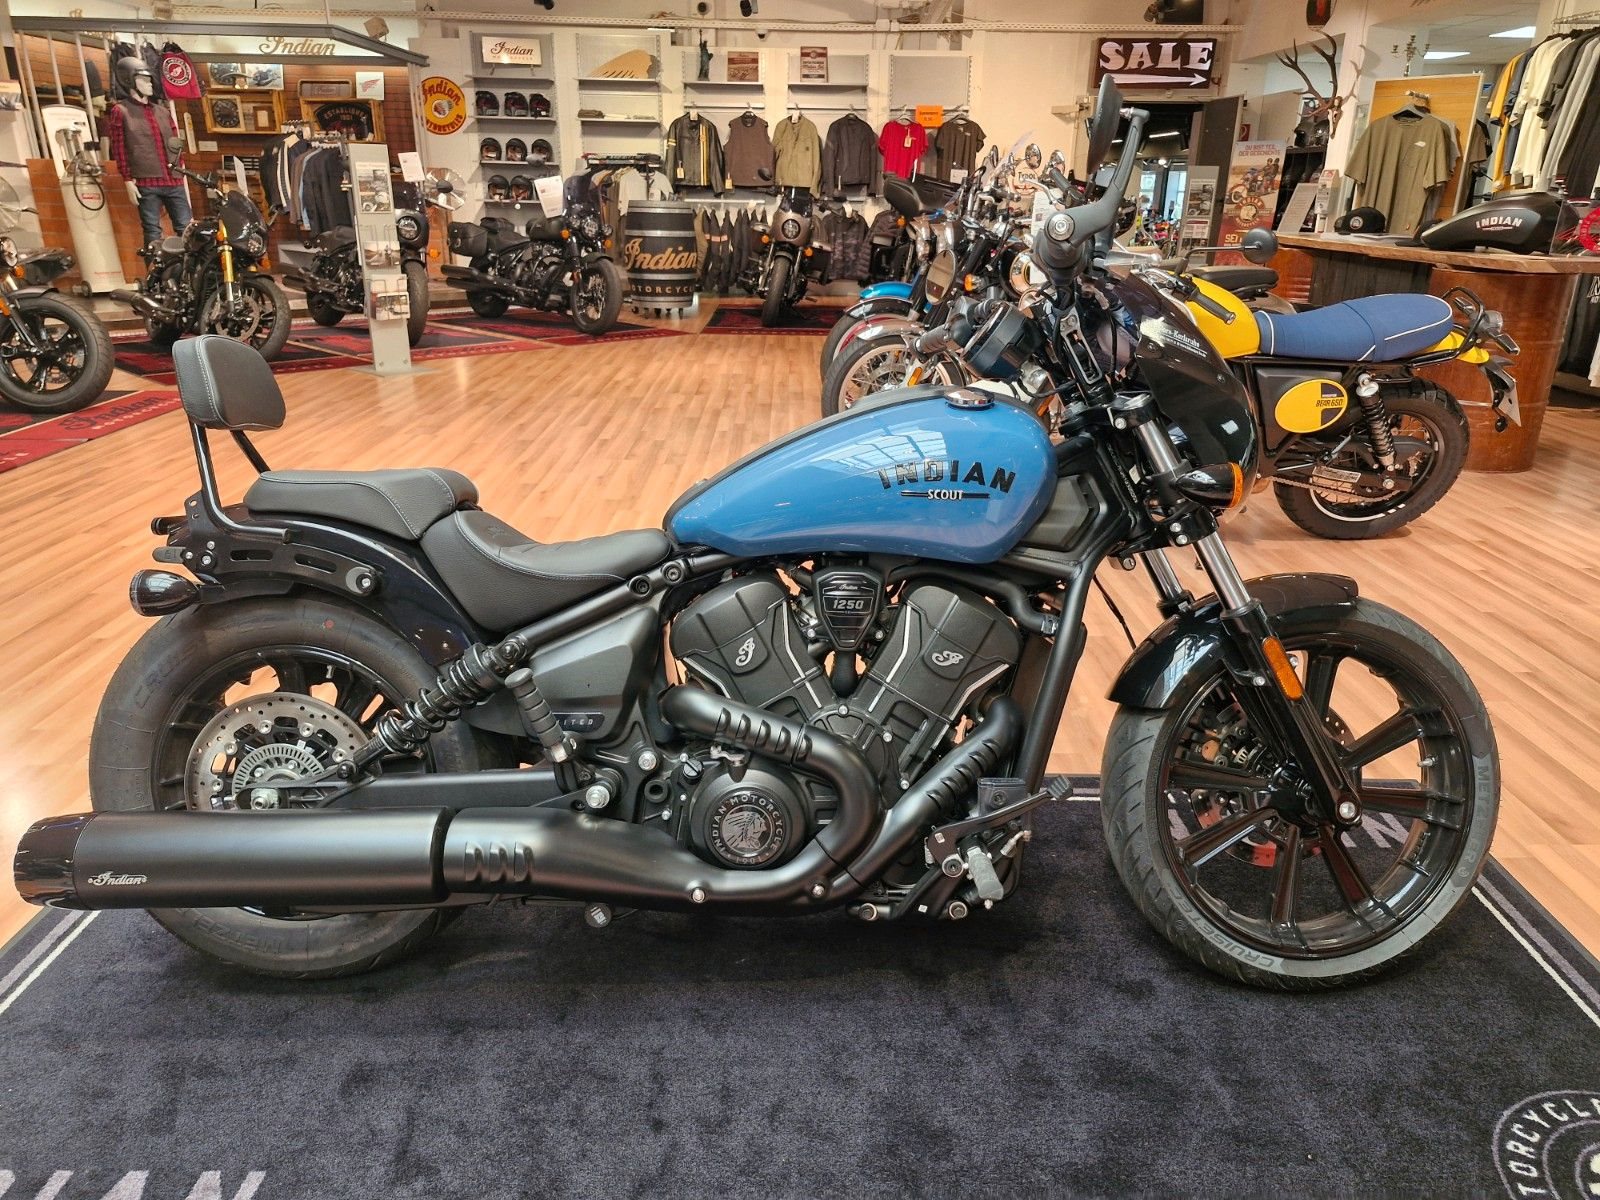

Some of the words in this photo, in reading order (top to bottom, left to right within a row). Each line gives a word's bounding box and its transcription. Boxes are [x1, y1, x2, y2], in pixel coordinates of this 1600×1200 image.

[258, 36, 336, 55] Indian
[490, 41, 534, 56] Indian
[1100, 41, 1213, 71] SALE
[1476, 216, 1523, 228] INDIAN
[625, 238, 697, 270] Indian
[1331, 398, 1344, 407] 650
[878, 459, 1016, 493] INDIAN
[928, 489, 964, 500] SCOUT
[833, 599, 864, 610] 1250
[712, 805, 727, 852] INDIAN
[729, 794, 783, 851] MOTORCYCLE
[92, 870, 143, 886] Indian
